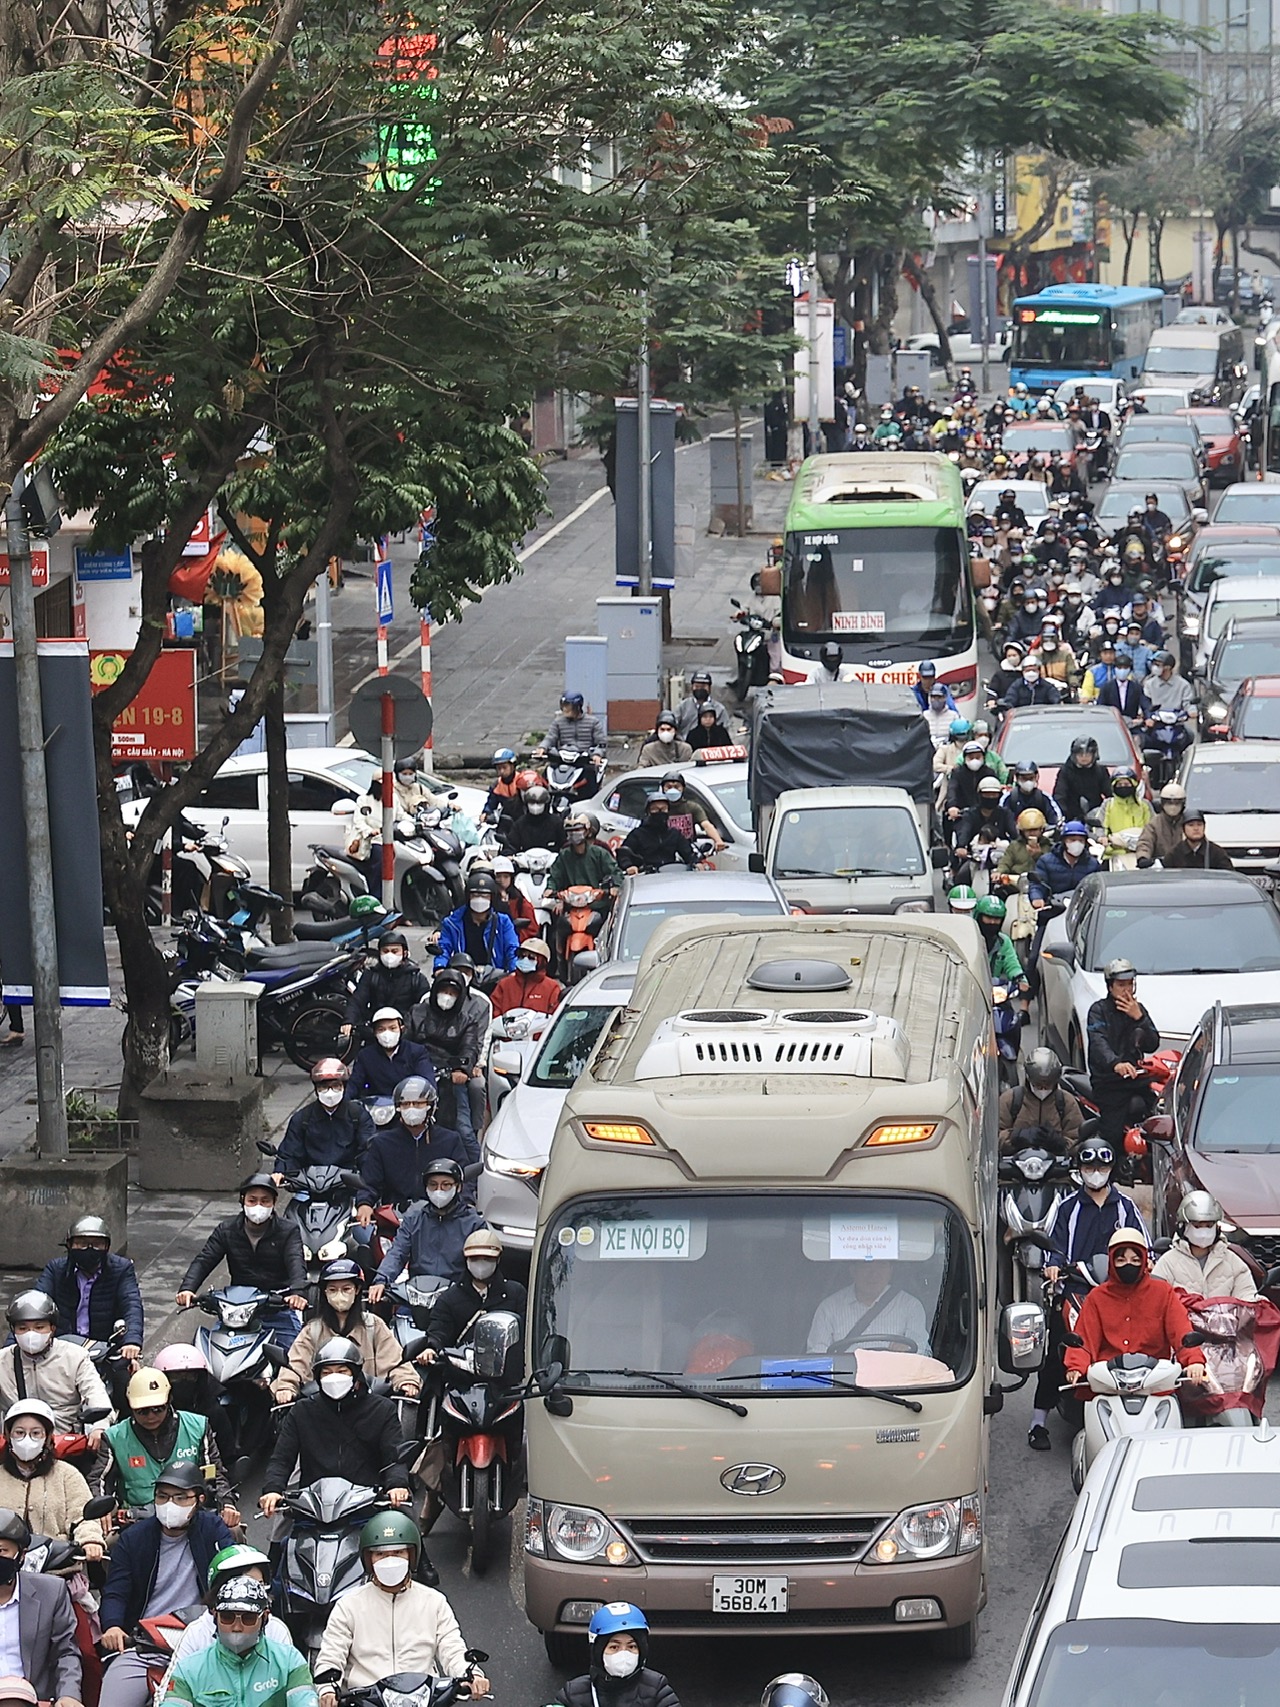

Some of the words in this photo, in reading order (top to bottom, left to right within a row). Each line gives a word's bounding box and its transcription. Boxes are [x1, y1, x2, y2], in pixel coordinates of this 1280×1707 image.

[834, 616, 858, 630] NINH
[860, 612, 884, 629] BÌNH
[142, 706, 184, 726] 19-8
[277, 989, 304, 1005] YAMAHA
[606, 1228, 626, 1250] XE
[631, 1224, 658, 1255] NỘI
[662, 1224, 685, 1255] BỘ
[876, 1428, 920, 1443] LIMOUSINE
[176, 1445, 198, 1459] Grab
[734, 1578, 767, 1594] 30M
[720, 1595, 777, 1611] 568.41
[253, 1677, 279, 1692] Grab
